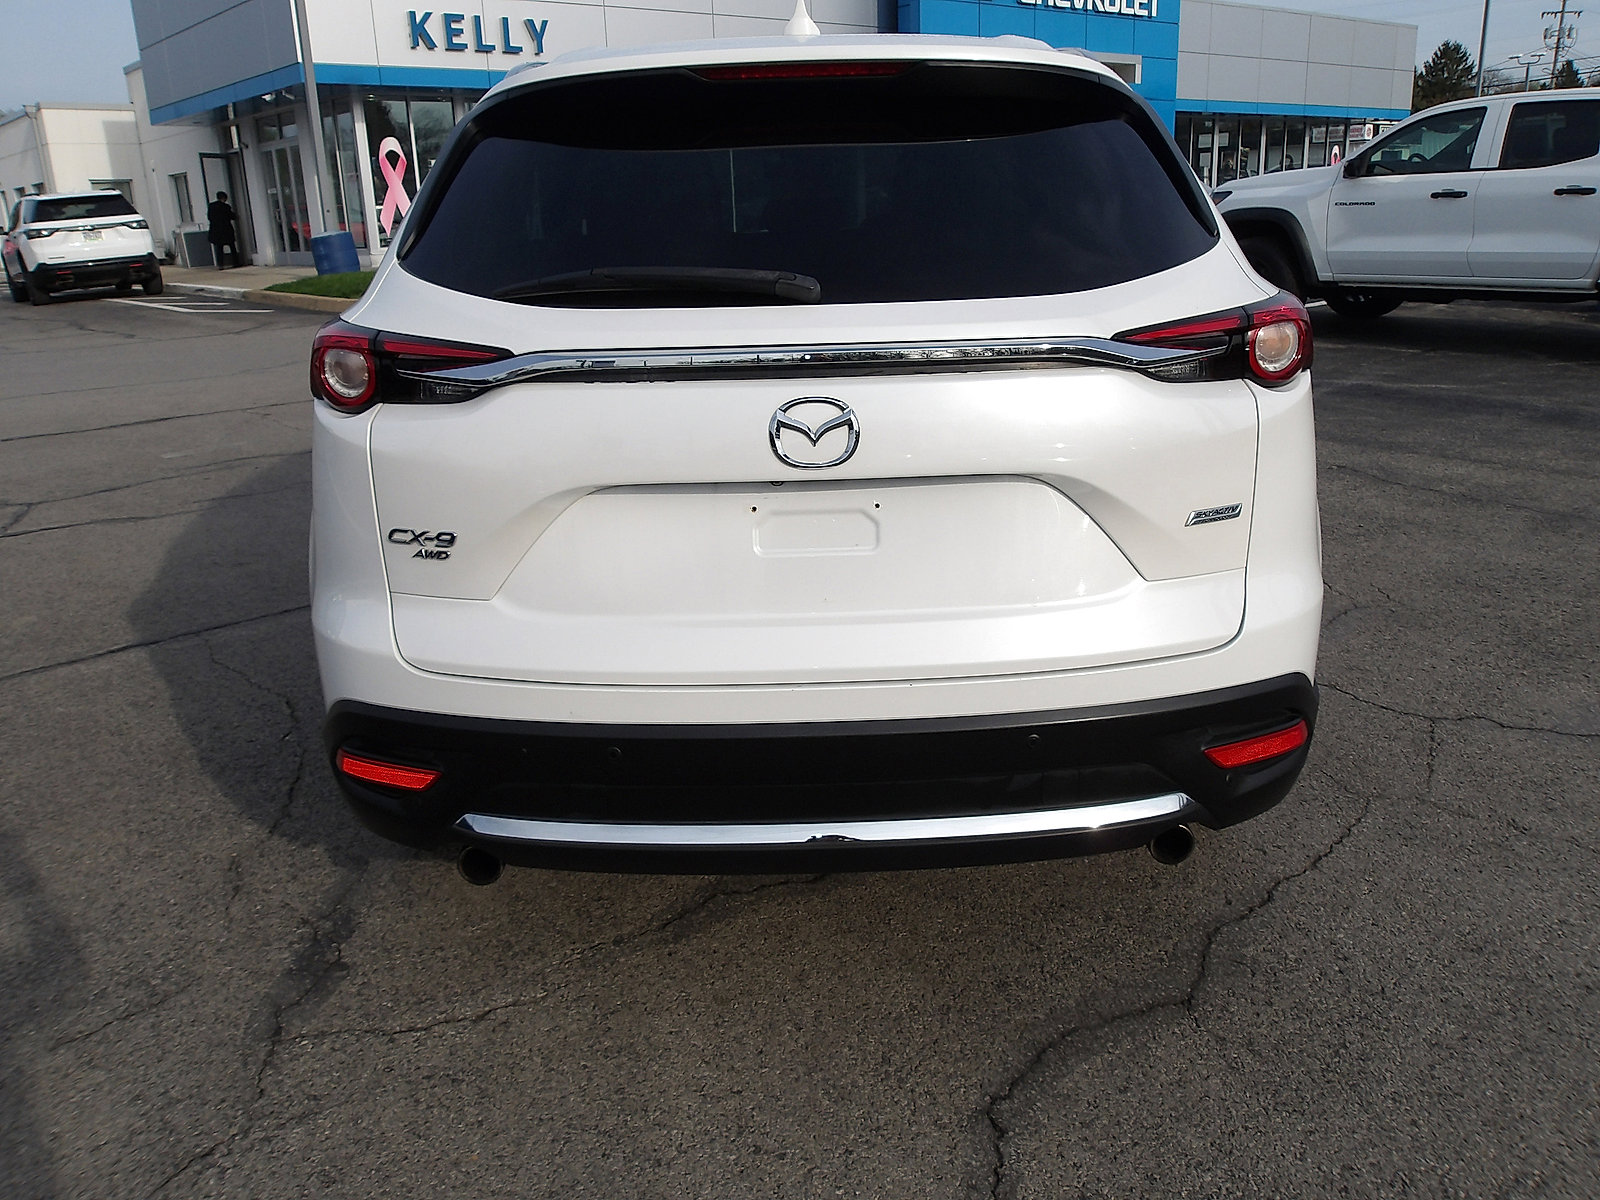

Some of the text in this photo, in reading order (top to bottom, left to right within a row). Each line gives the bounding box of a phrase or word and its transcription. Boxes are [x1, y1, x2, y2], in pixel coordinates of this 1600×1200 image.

[407, 10, 549, 56] KELLY
[388, 528, 457, 548] CX-9
[412, 548, 450, 560] AWD
